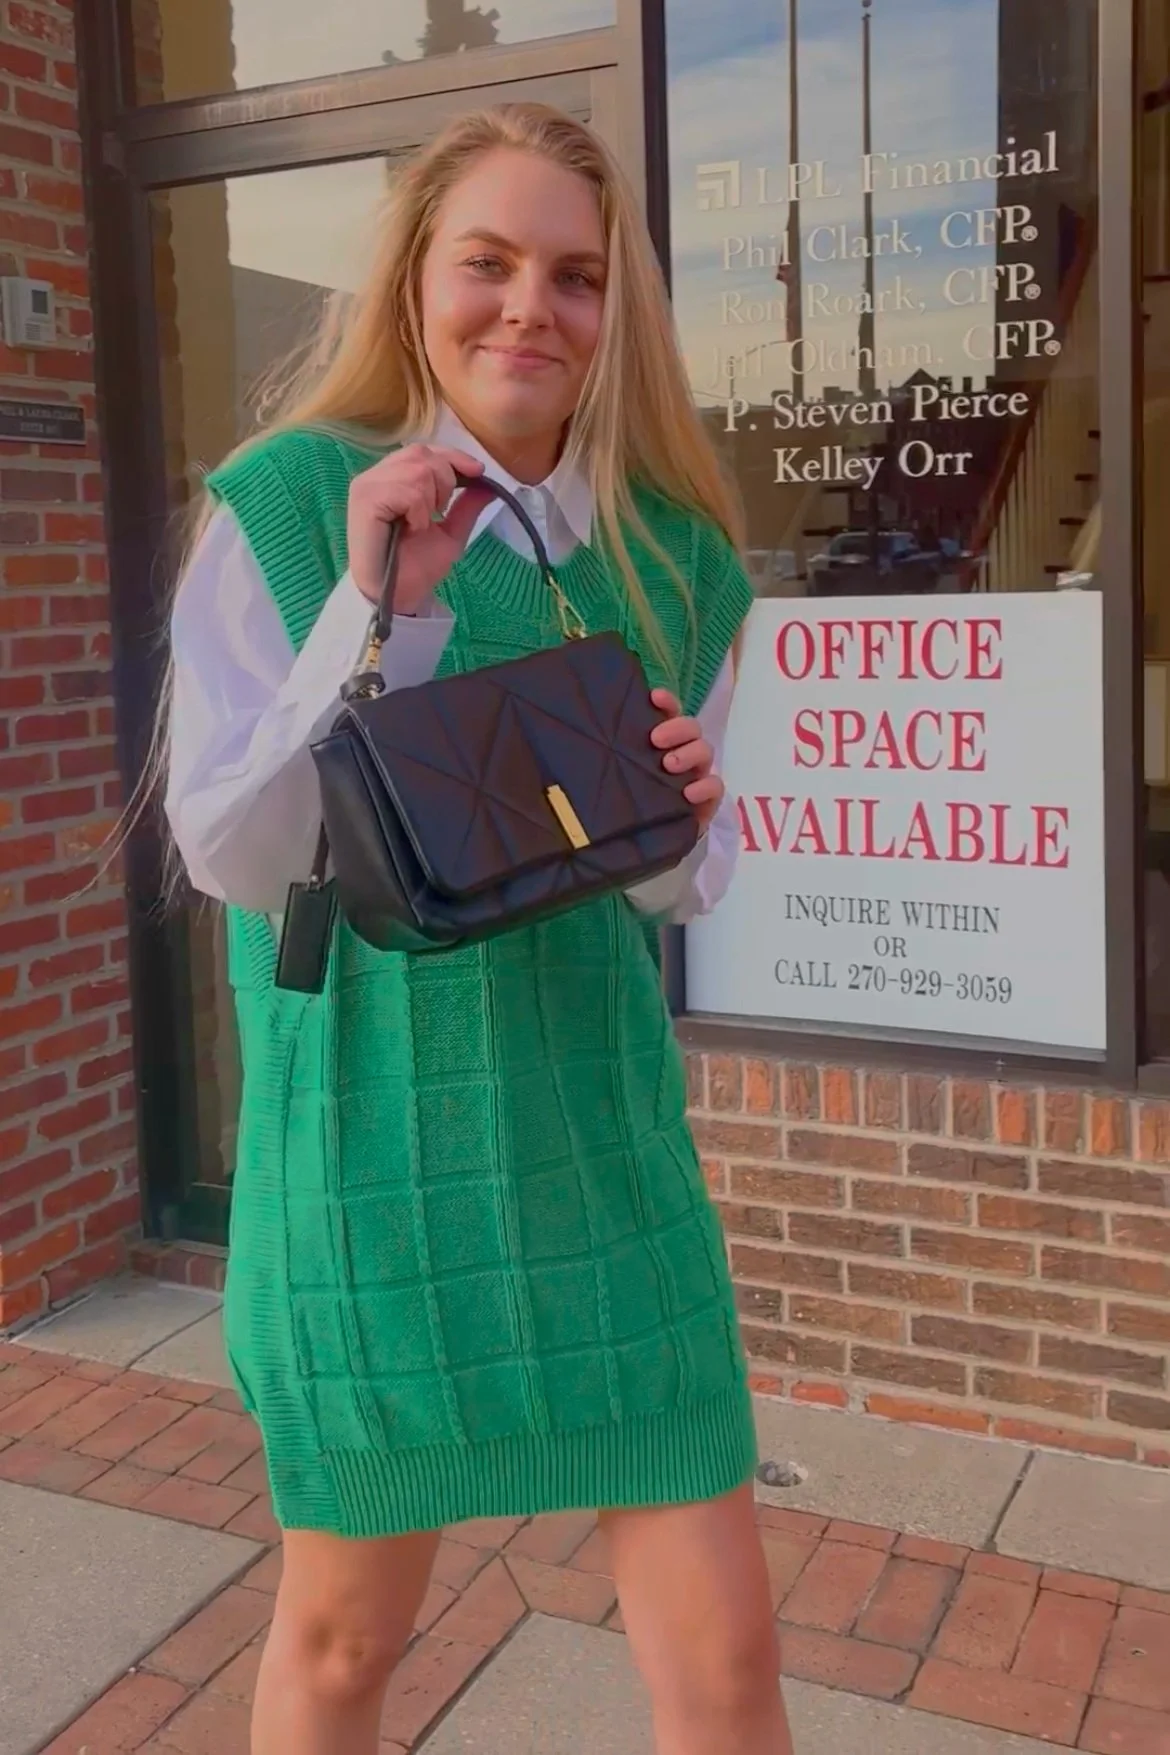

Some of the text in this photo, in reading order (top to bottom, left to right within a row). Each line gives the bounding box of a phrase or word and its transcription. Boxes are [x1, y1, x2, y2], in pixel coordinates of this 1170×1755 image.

[757, 131, 1060, 205] LPL Financial
[722, 231, 792, 271] Phil
[806, 219, 923, 263] Clark,
[720, 291, 788, 326] Ron
[807, 275, 926, 319] Roark,
[724, 384, 1029, 432] P. Steven Pierce
[774, 440, 973, 490] Kelley Orr
[775, 618, 1003, 681] OFFICE
[793, 708, 986, 771] SPACE
[737, 795, 1070, 868] AVAILABLE
[784, 894, 999, 934] INQUIRE WITHIN
[873, 935, 907, 958] OR
[774, 959, 1012, 1004] CALL 270-929-3059
